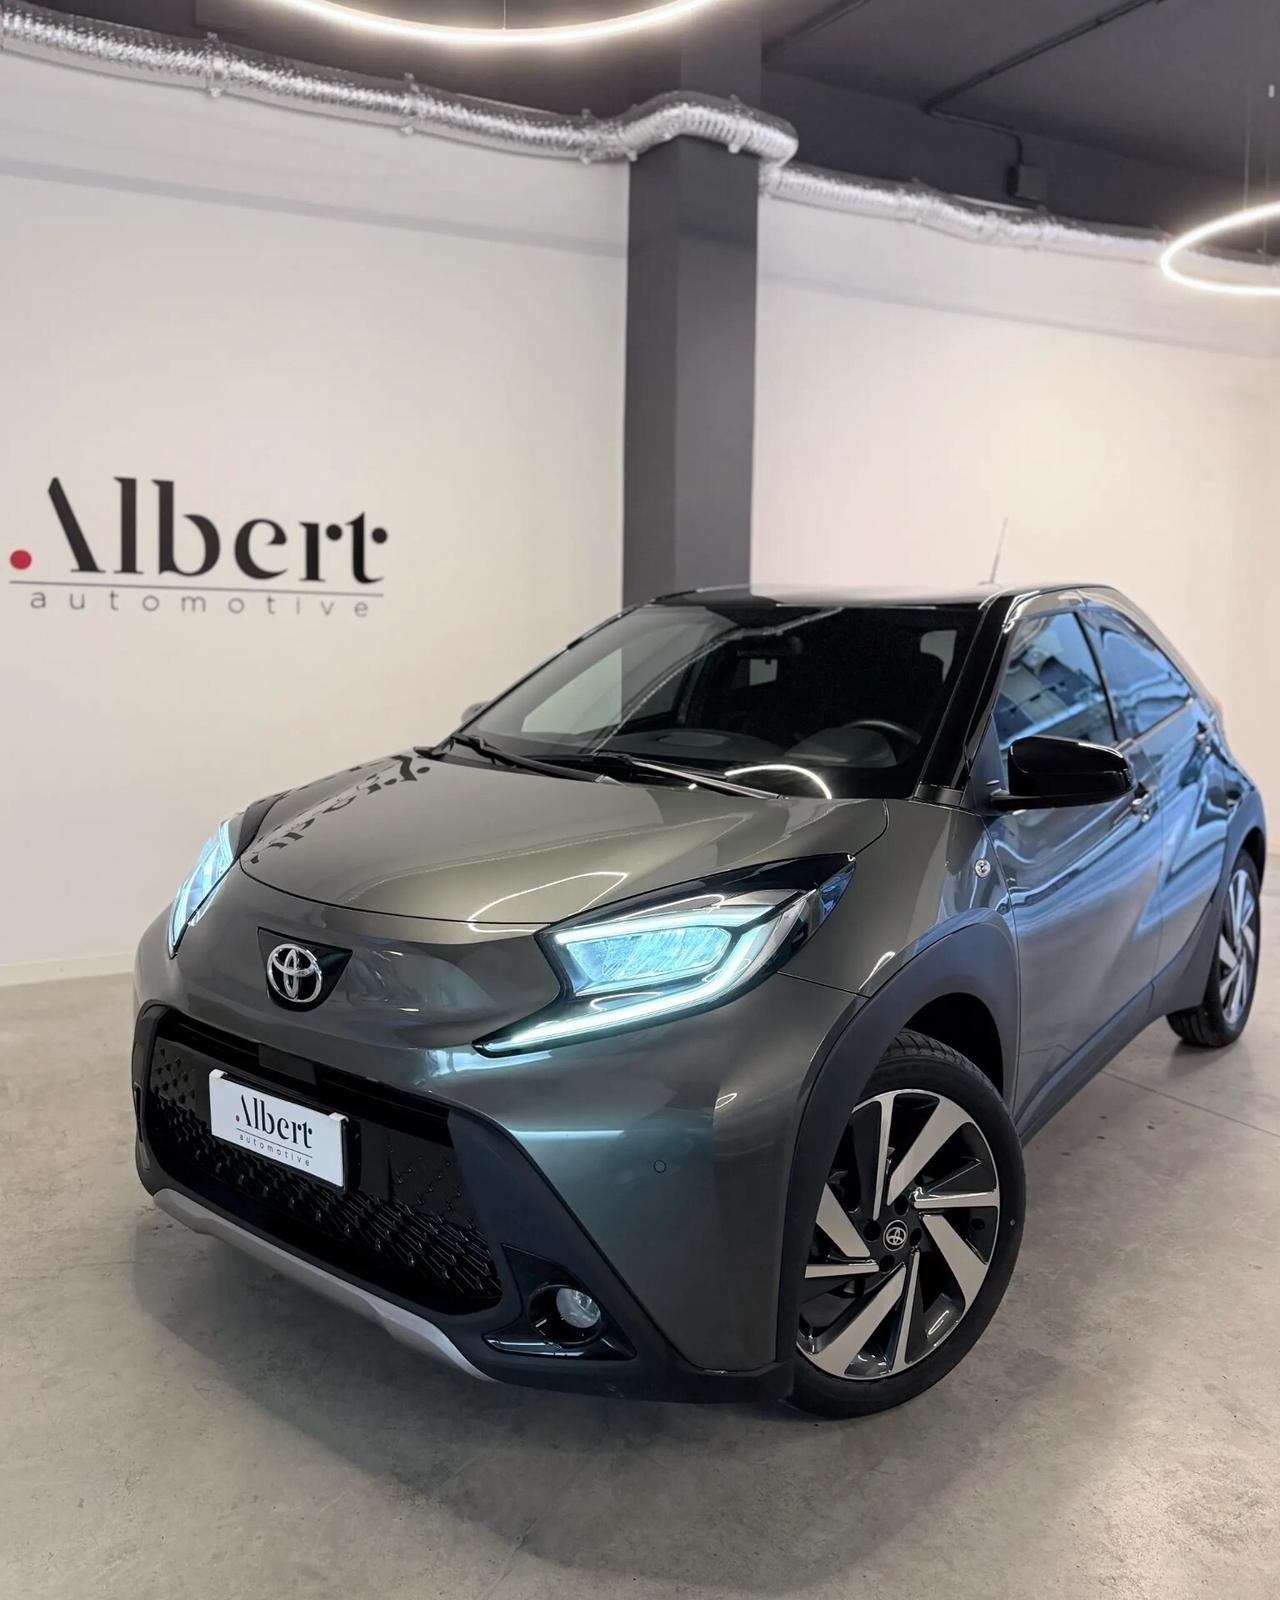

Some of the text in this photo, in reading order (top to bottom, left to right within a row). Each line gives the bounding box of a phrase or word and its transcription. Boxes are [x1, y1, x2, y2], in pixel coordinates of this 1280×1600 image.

[9, 476, 389, 584] Albert
[29, 589, 370, 618] automotive
[239, 1133, 311, 1167] automotive
